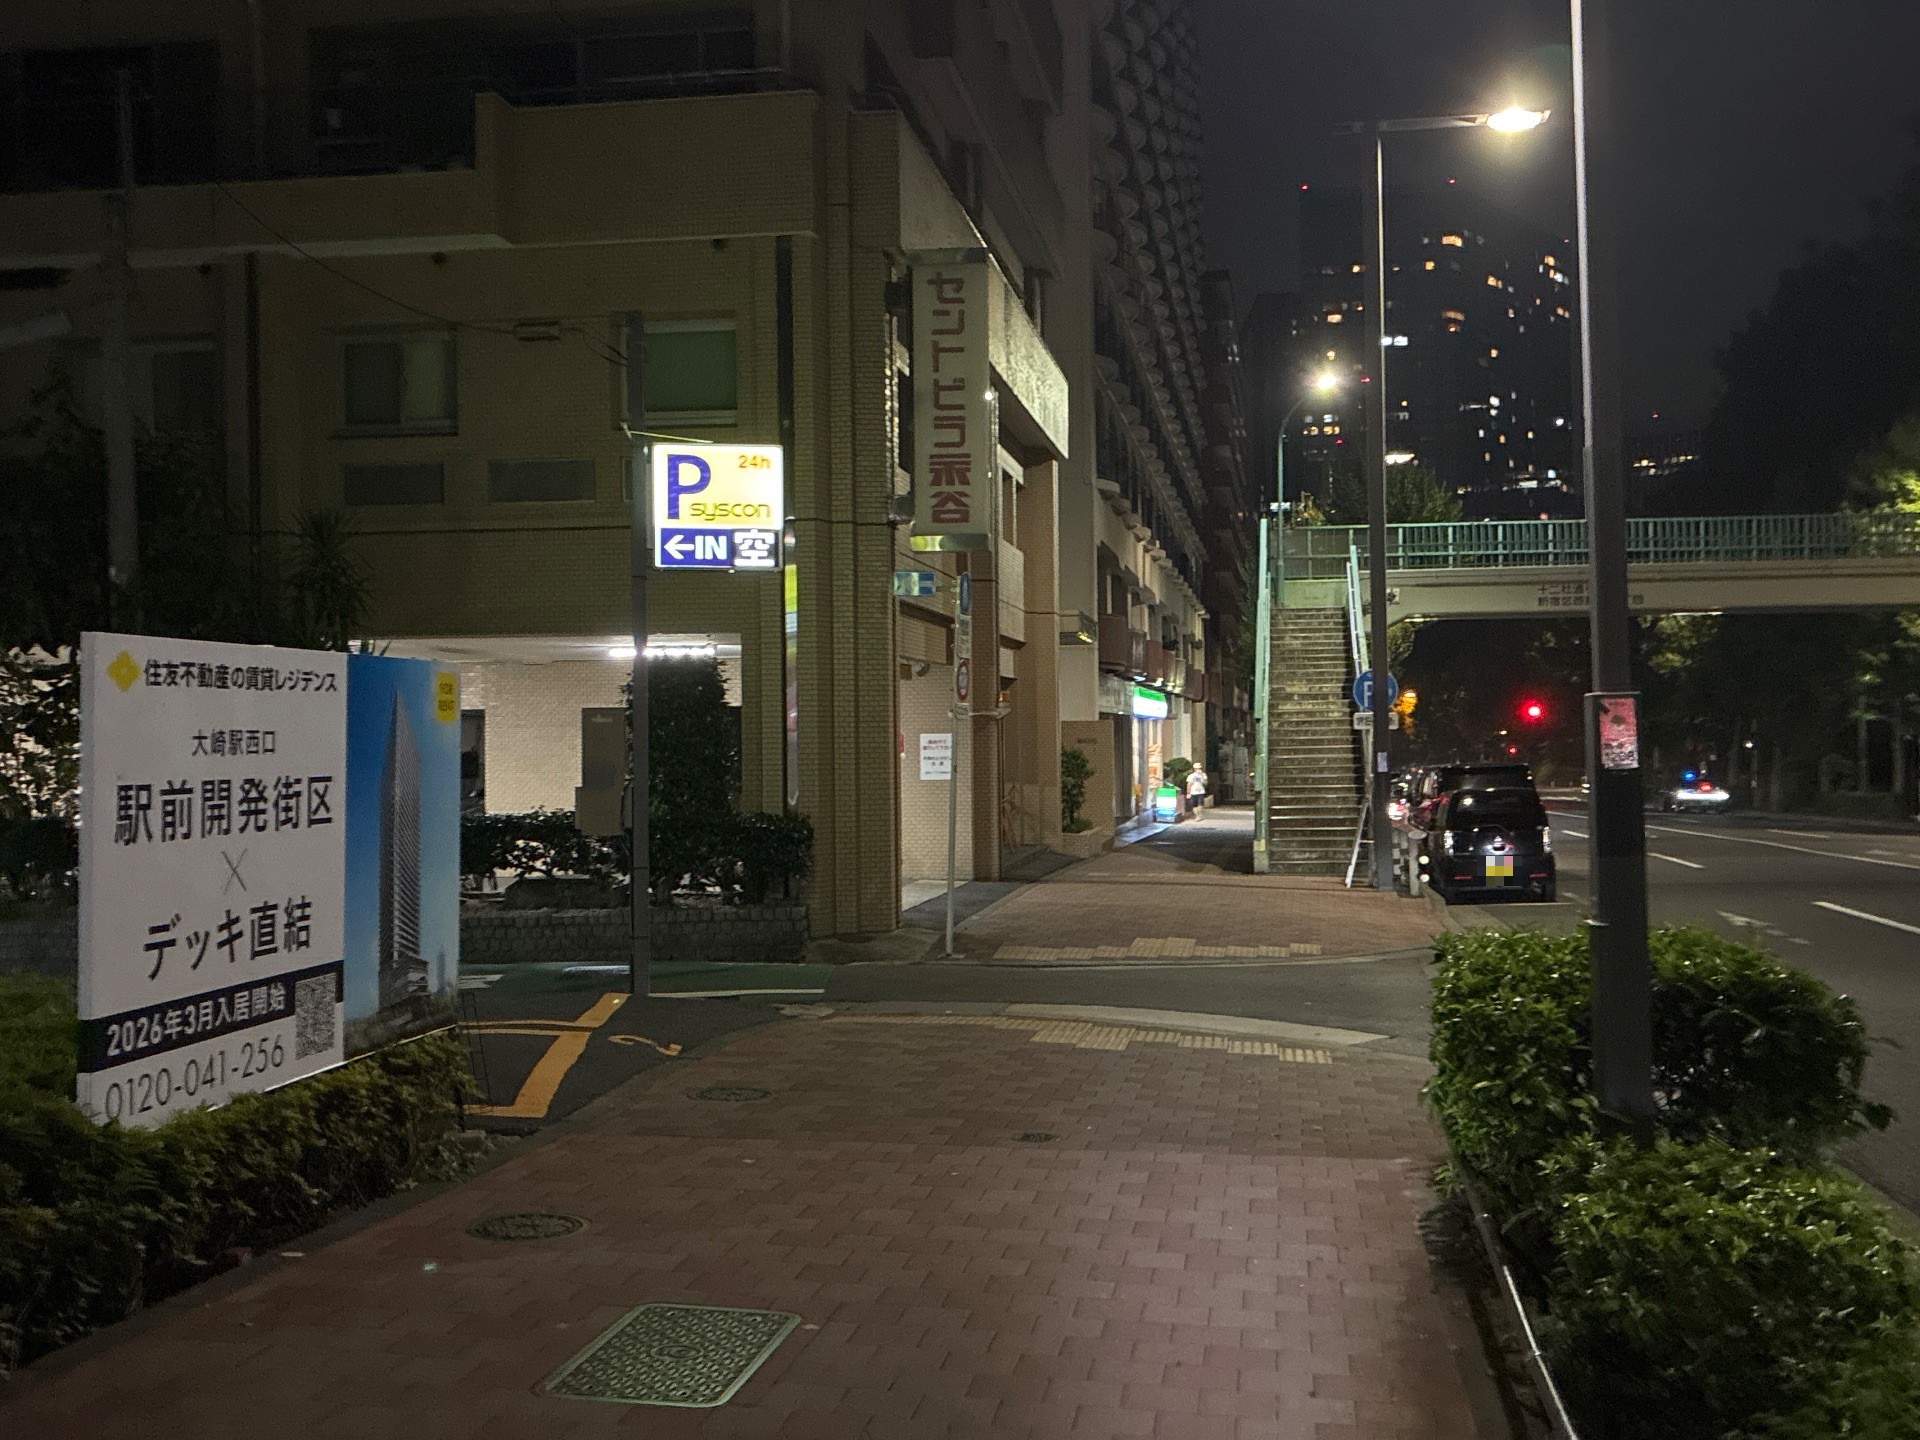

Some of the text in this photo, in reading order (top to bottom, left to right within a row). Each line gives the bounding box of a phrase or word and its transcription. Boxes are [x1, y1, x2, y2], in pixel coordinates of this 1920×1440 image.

[738, 454, 771, 469] 24h
[667, 453, 712, 520] P
[690, 502, 771, 521] syscon
[694, 534, 728, 560] IN
[733, 528, 776, 567] 空
[143, 658, 338, 692] 住友不動産の賃貸レジデンス
[191, 729, 276, 757] 大崎駅西口
[114, 775, 333, 846] 駅前開発街区
[143, 895, 313, 982] デッキ直結
[106, 982, 287, 1057] 2026年3月入居開始
[105, 1034, 285, 1120] 0120-041-256
